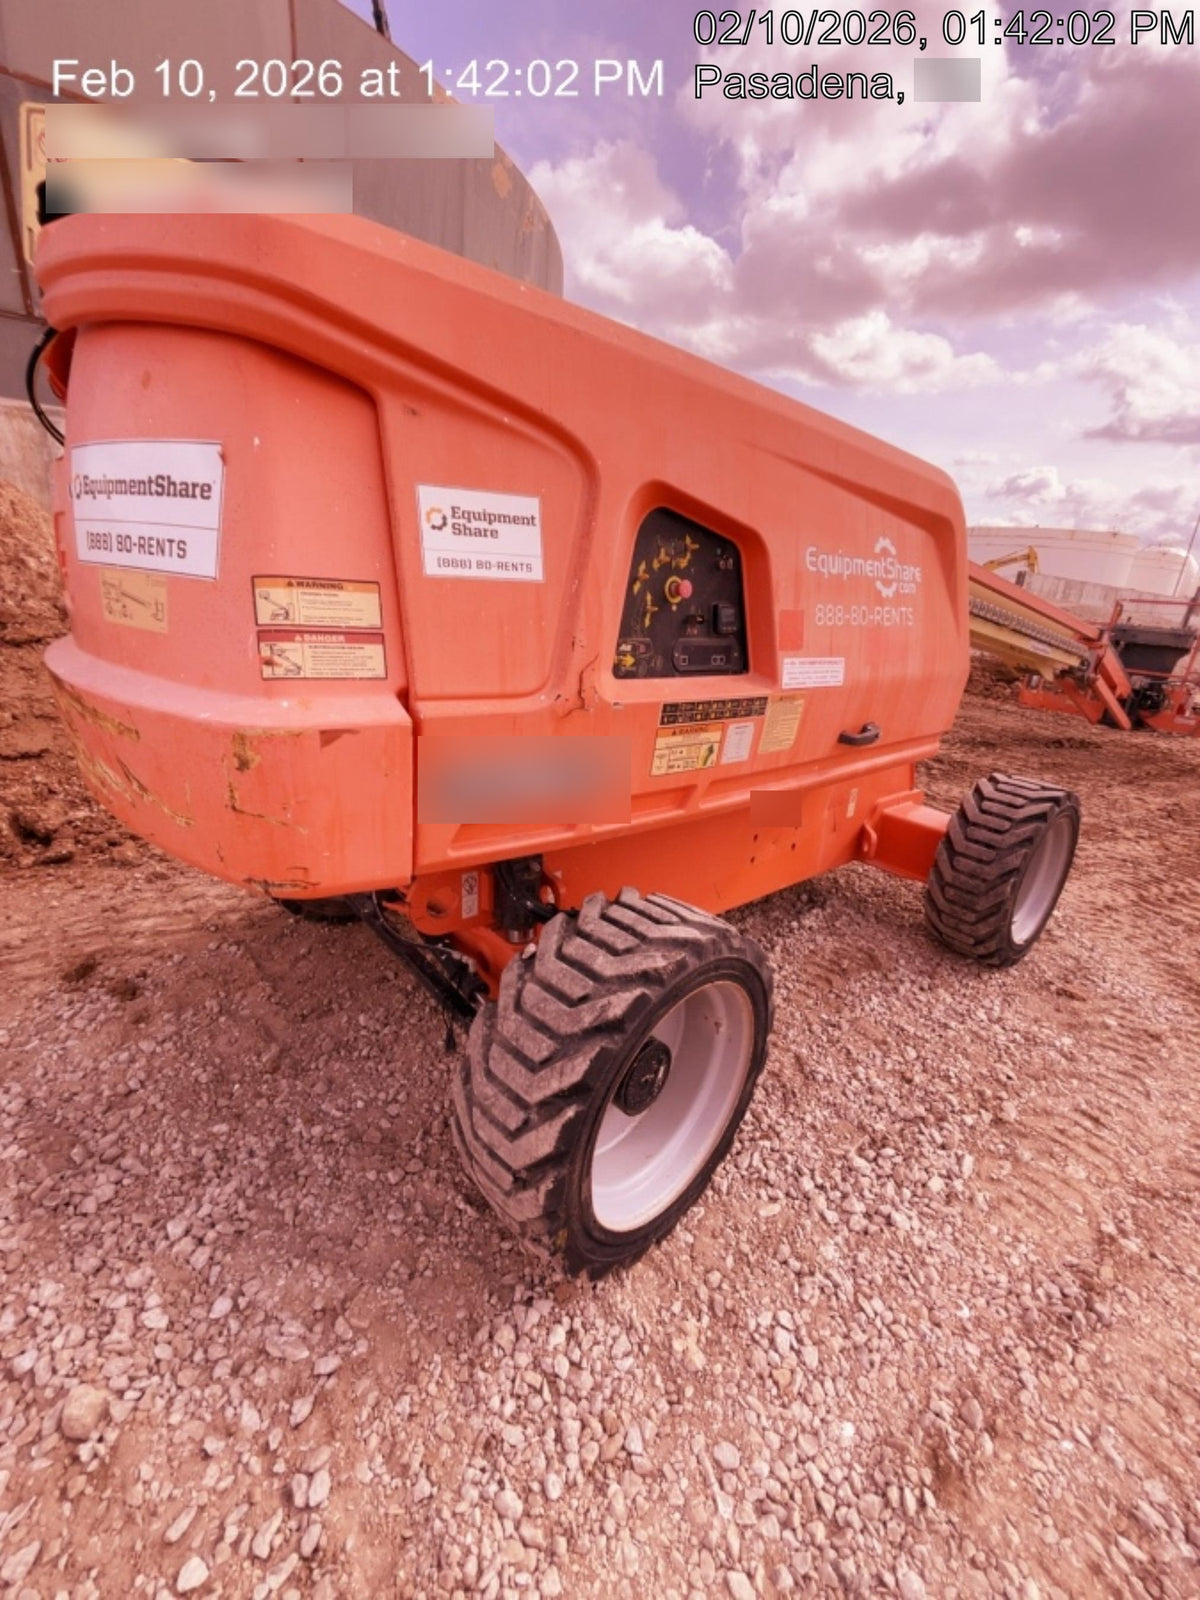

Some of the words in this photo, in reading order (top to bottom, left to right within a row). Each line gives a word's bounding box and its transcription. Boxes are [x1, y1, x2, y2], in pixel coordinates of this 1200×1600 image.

[83, 474, 212, 501] EquipmentShare
[451, 505, 536, 526] Equipment
[452, 522, 499, 538] Share
[116, 534, 187, 559] 80-RENTS
[475, 559, 533, 573] 80-RENTS
[805, 546, 922, 582] EquipmentShare
[815, 604, 914, 626] 888-80-RENTS
